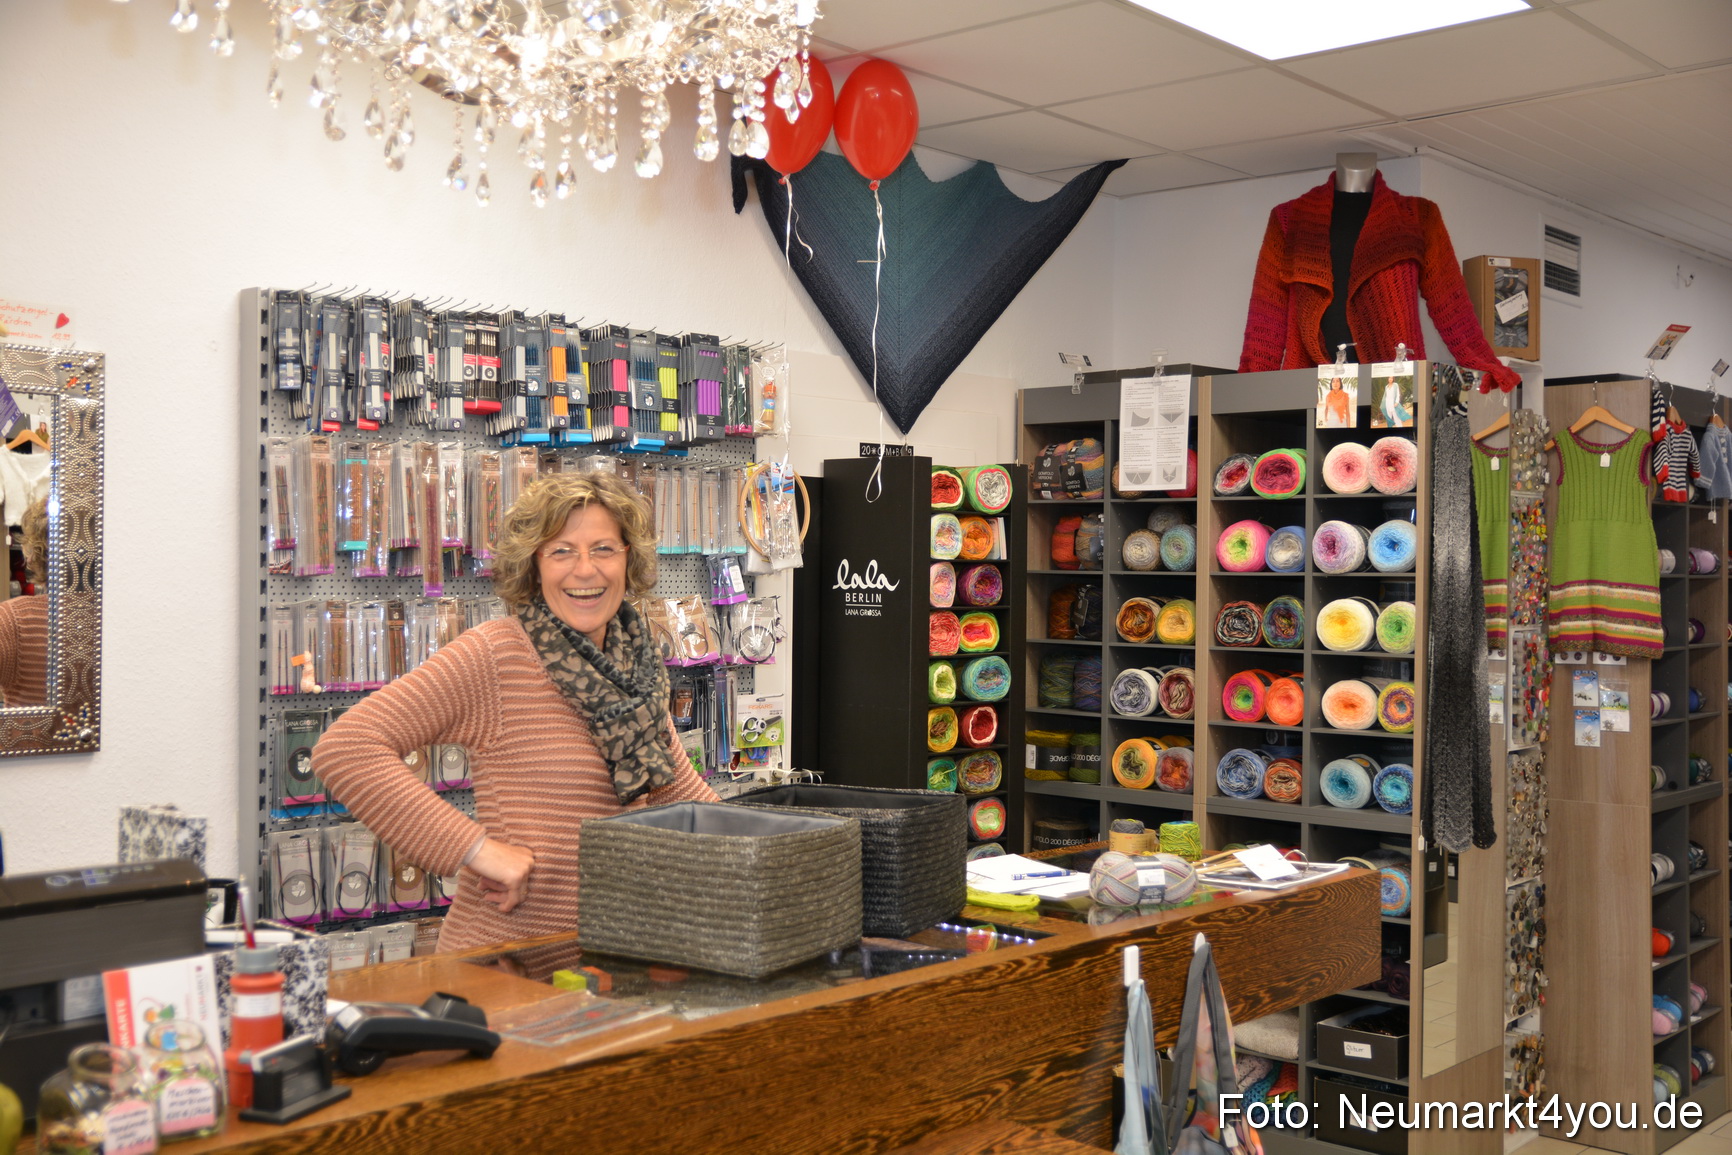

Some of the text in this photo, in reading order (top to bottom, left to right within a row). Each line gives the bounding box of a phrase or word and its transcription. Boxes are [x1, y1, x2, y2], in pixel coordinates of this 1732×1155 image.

[832, 558, 900, 592] lala
[845, 592, 882, 603] BERLIN
[845, 608, 882, 617] LANA GROSSA
